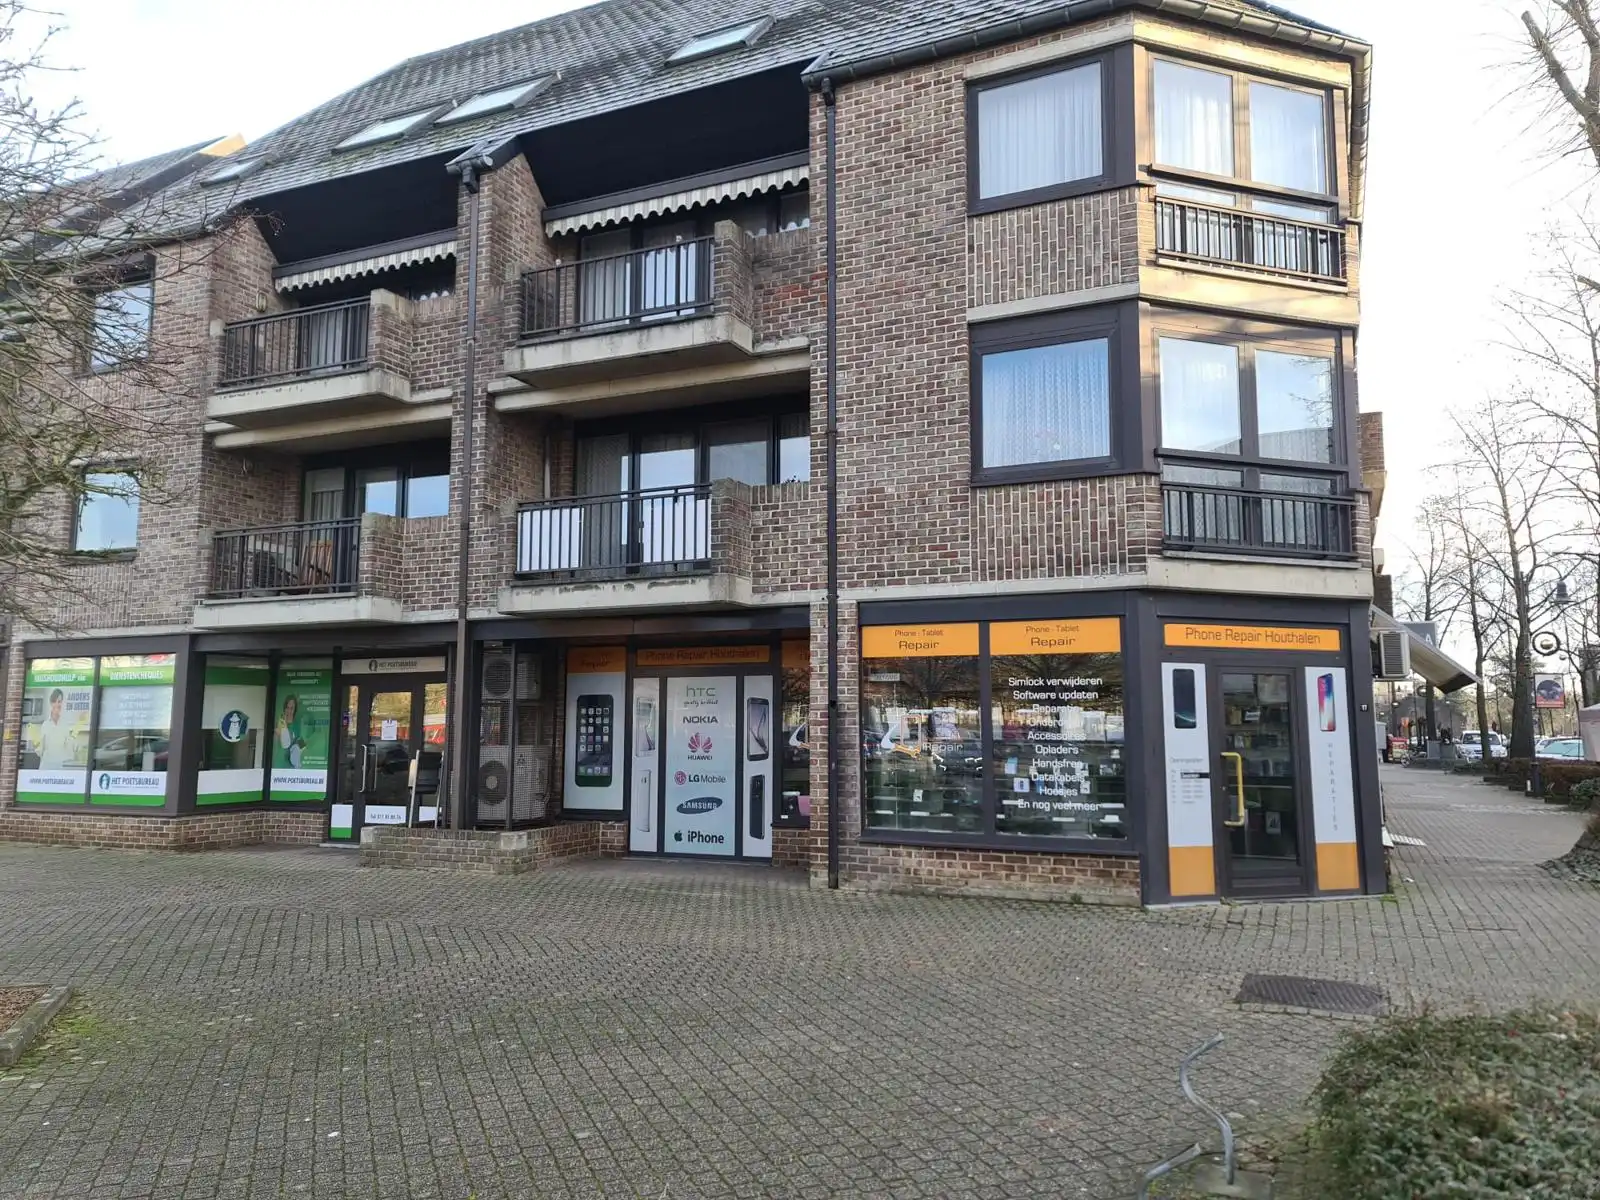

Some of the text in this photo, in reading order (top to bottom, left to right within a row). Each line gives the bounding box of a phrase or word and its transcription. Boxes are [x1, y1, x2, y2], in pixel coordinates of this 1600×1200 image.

[894, 629, 917, 637] Phone
[922, 629, 944, 637] Tablet
[1025, 625, 1050, 633] Phone
[1056, 624, 1079, 633] Tablet
[1186, 627, 1321, 645] Phone Repair Houthalen
[898, 640, 940, 651] Repair
[1030, 637, 1076, 648] Repair
[1008, 677, 1103, 688] Simlock verwijderen
[1013, 690, 1099, 701] Software updaten
[682, 715, 719, 724] NOKIA
[1035, 744, 1079, 755] Opladers
[111, 776, 121, 785] HET
[121, 777, 160, 786] POETSBUREAU
[688, 774, 727, 784] LG Mobile
[1031, 772, 1086, 783] Datakabels
[1039, 784, 1078, 798] Hoesjes
[682, 801, 718, 810] SAMSUNG
[1018, 799, 1100, 812] En nog veel meer
[687, 829, 725, 844] iPhone
